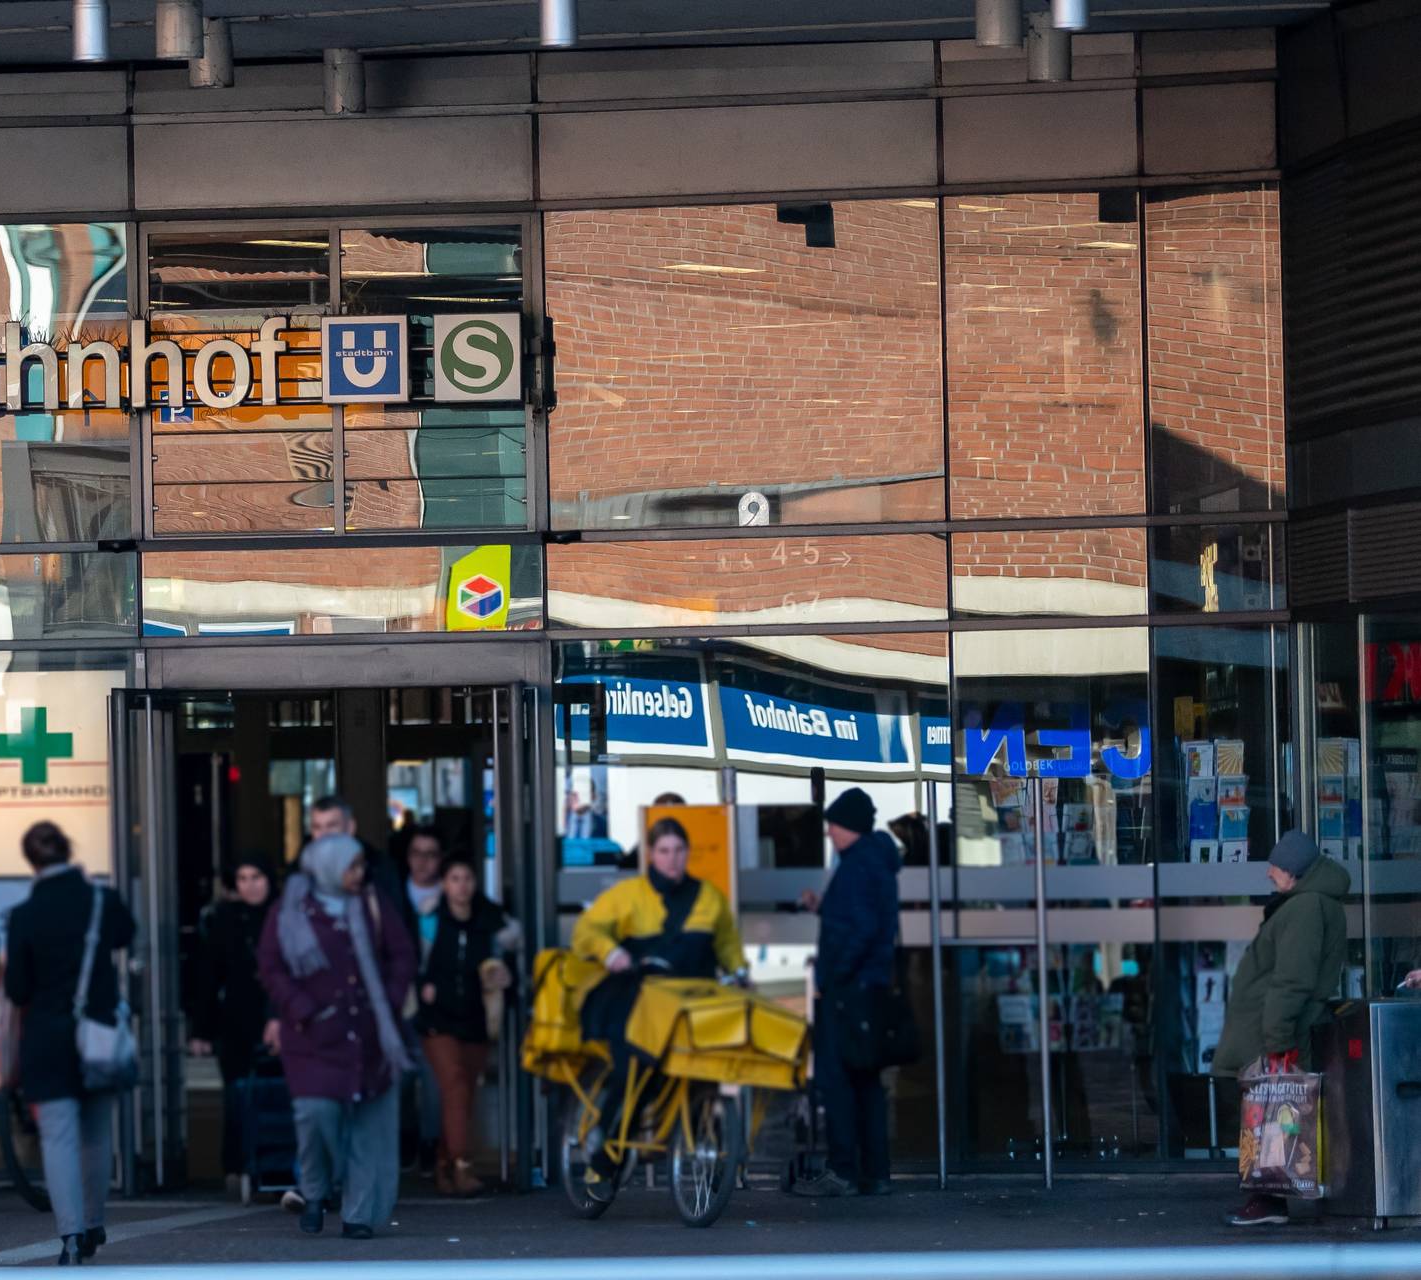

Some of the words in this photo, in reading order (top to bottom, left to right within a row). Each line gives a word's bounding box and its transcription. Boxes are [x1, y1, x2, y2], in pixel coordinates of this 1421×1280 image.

[335, 349, 394, 358] stadtbahn
[342, 331, 387, 388] U
[452, 326, 502, 387] S
[771, 540, 819, 565] 4-5
